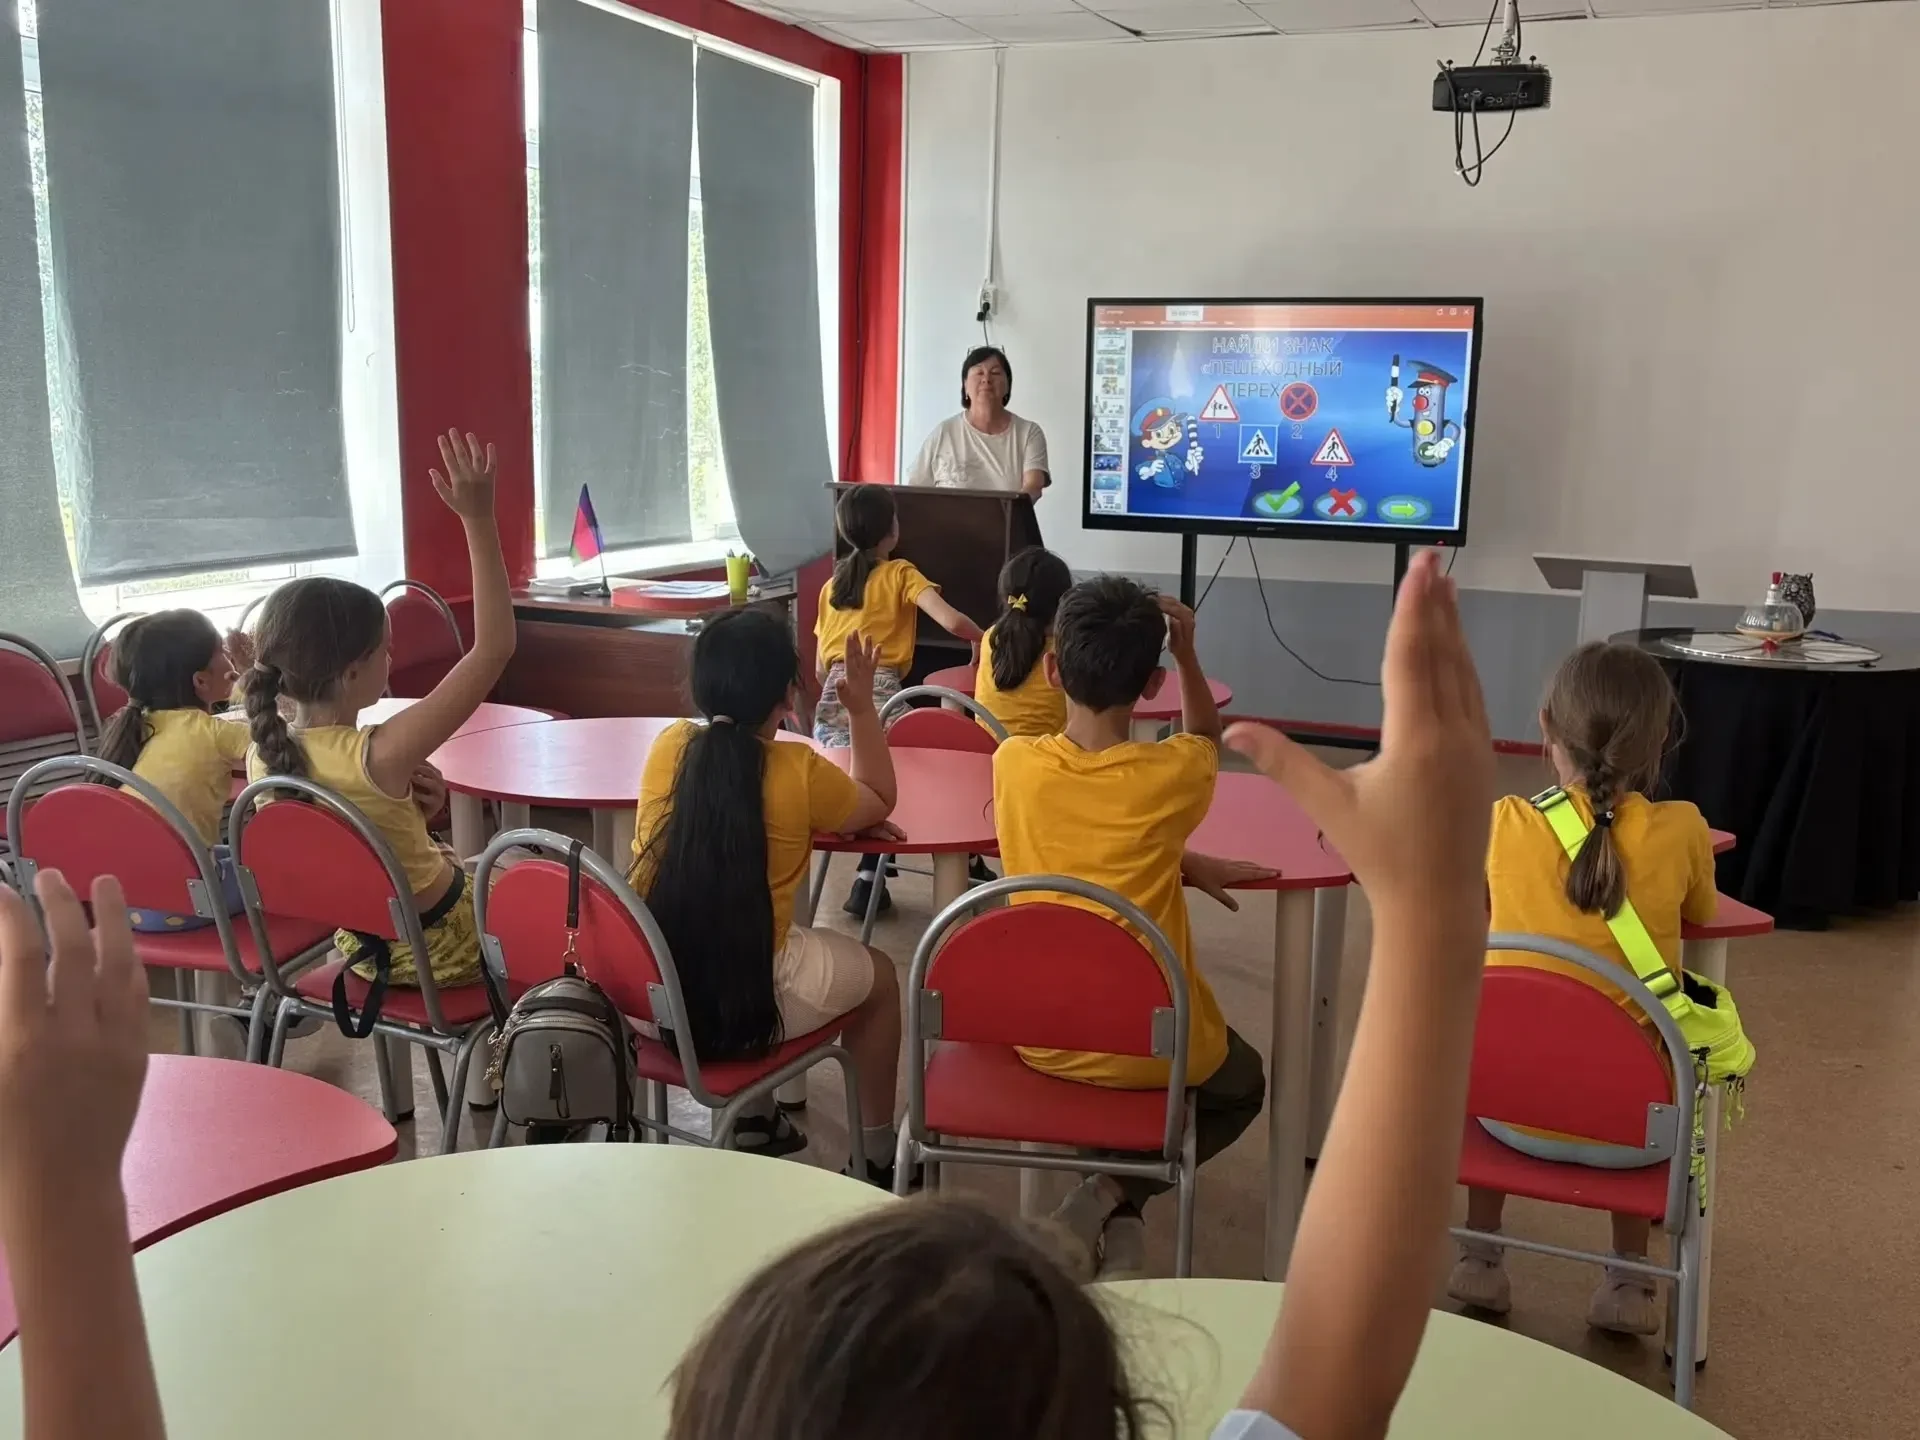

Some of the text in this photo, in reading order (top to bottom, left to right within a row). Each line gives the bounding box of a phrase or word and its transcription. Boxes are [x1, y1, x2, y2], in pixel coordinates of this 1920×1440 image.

[1212, 333, 1333, 357] НАЙДИ ЗНАК
[1224, 382, 1288, 398] ПЕРЕХ
[1213, 424, 1221, 439] 1
[1291, 424, 1303, 440] 2
[1250, 464, 1261, 479] 3
[1325, 465, 1338, 482] 4
